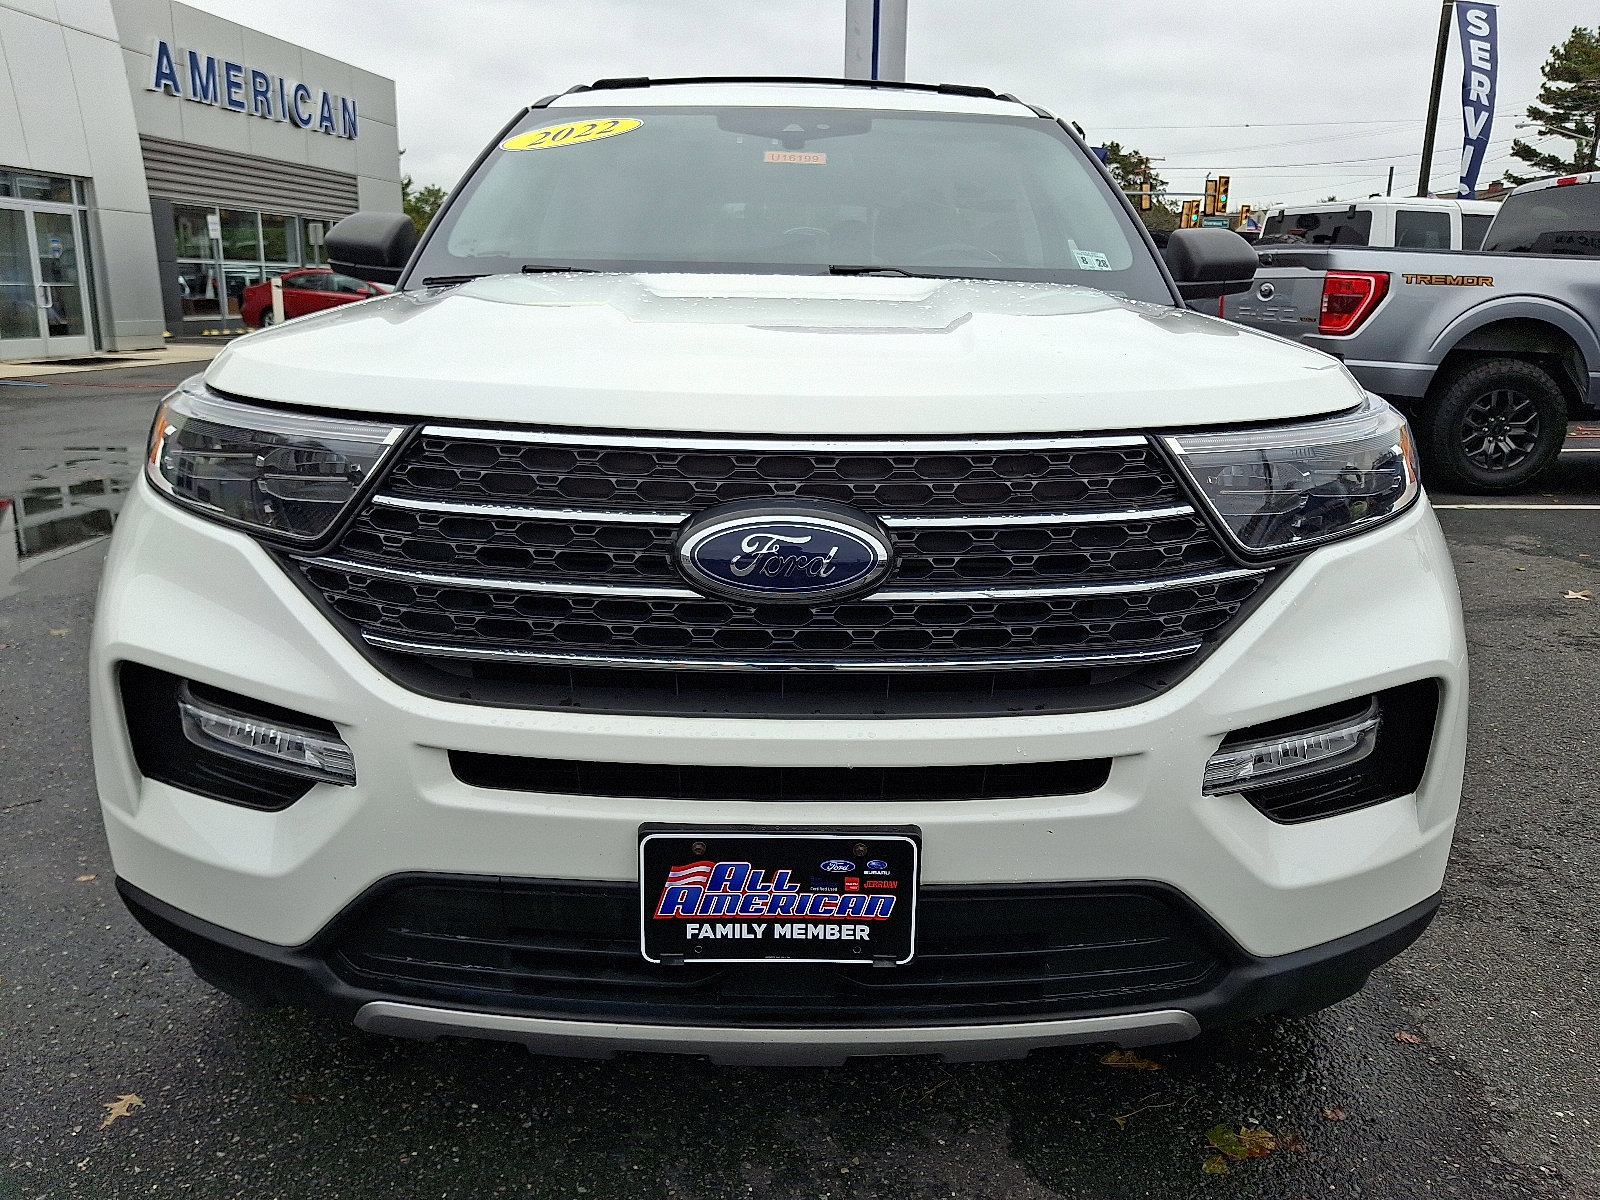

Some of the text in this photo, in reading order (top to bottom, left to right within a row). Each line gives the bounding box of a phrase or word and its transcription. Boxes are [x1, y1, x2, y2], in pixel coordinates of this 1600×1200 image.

[153, 39, 359, 140] AMERICAN
[526, 120, 620, 147] 2022
[771, 154, 819, 162] U16199
[1402, 273, 1494, 287] TREMOR
[730, 533, 838, 577] Ford
[686, 923, 870, 941] FAMILY MEMBER
